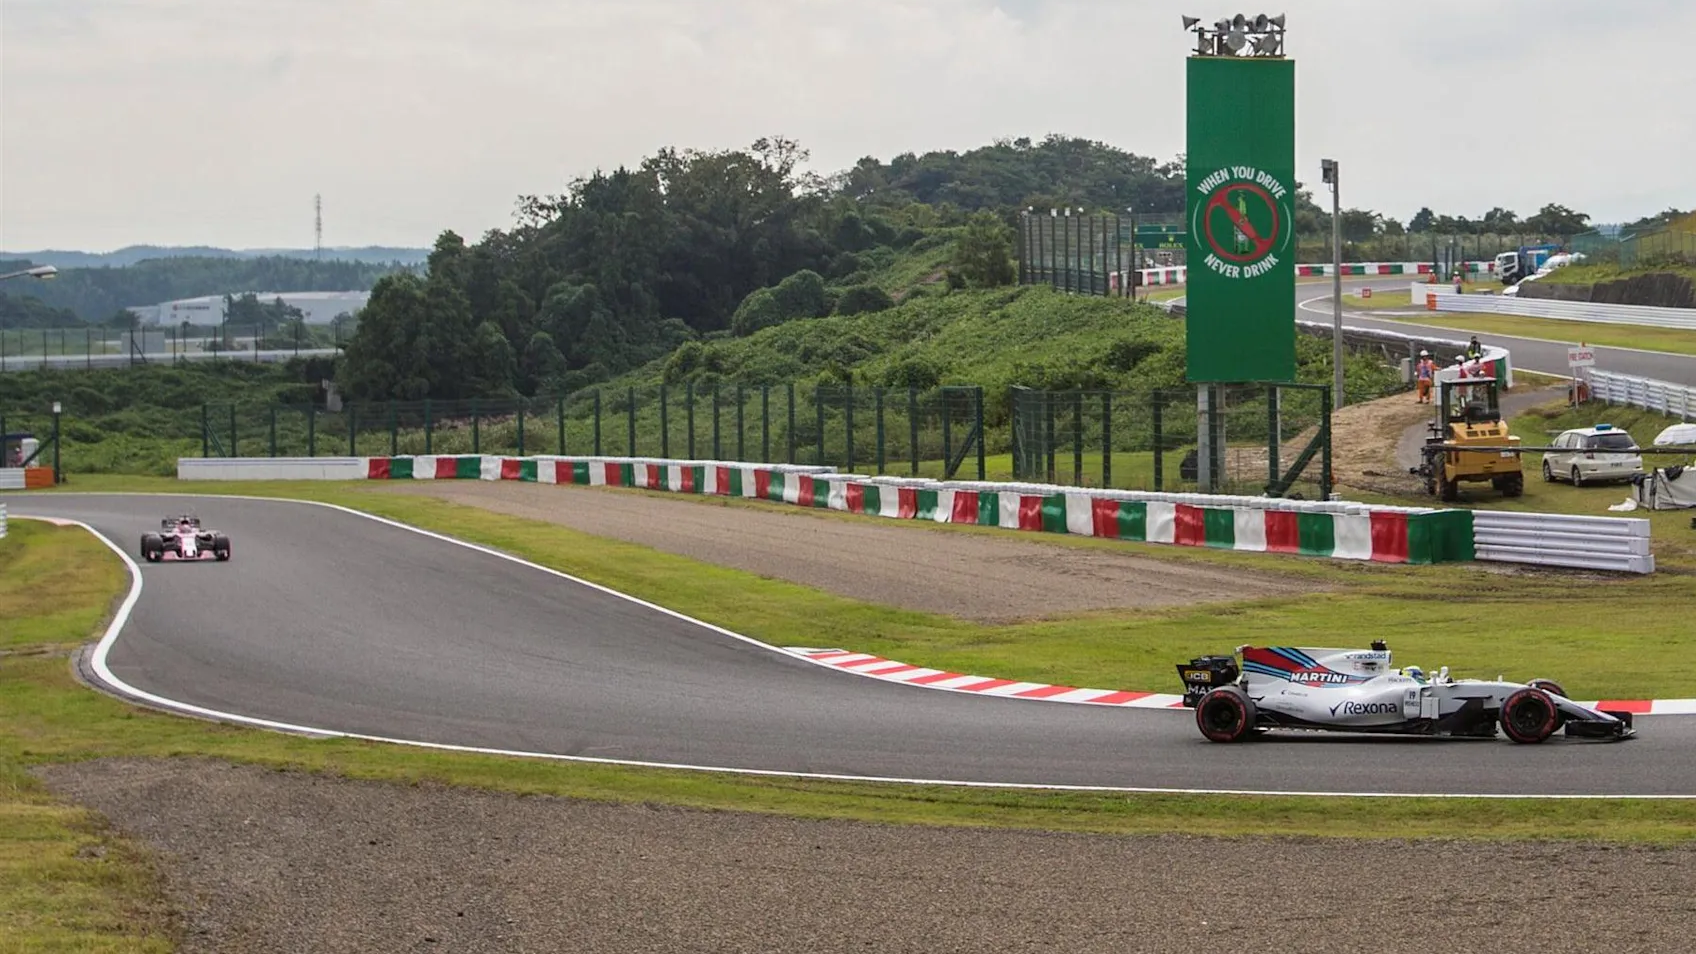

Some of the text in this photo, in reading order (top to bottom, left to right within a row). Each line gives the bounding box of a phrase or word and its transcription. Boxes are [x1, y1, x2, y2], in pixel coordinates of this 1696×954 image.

[1197, 166, 1287, 199] WHEN YOU DRIVE
[1204, 253, 1279, 278] NEVER DRINK
[1353, 652, 1387, 660] randstad
[1186, 672, 1210, 680] JCB
[1289, 672, 1349, 684] MARTINI
[1344, 701, 1398, 715] Rexona
